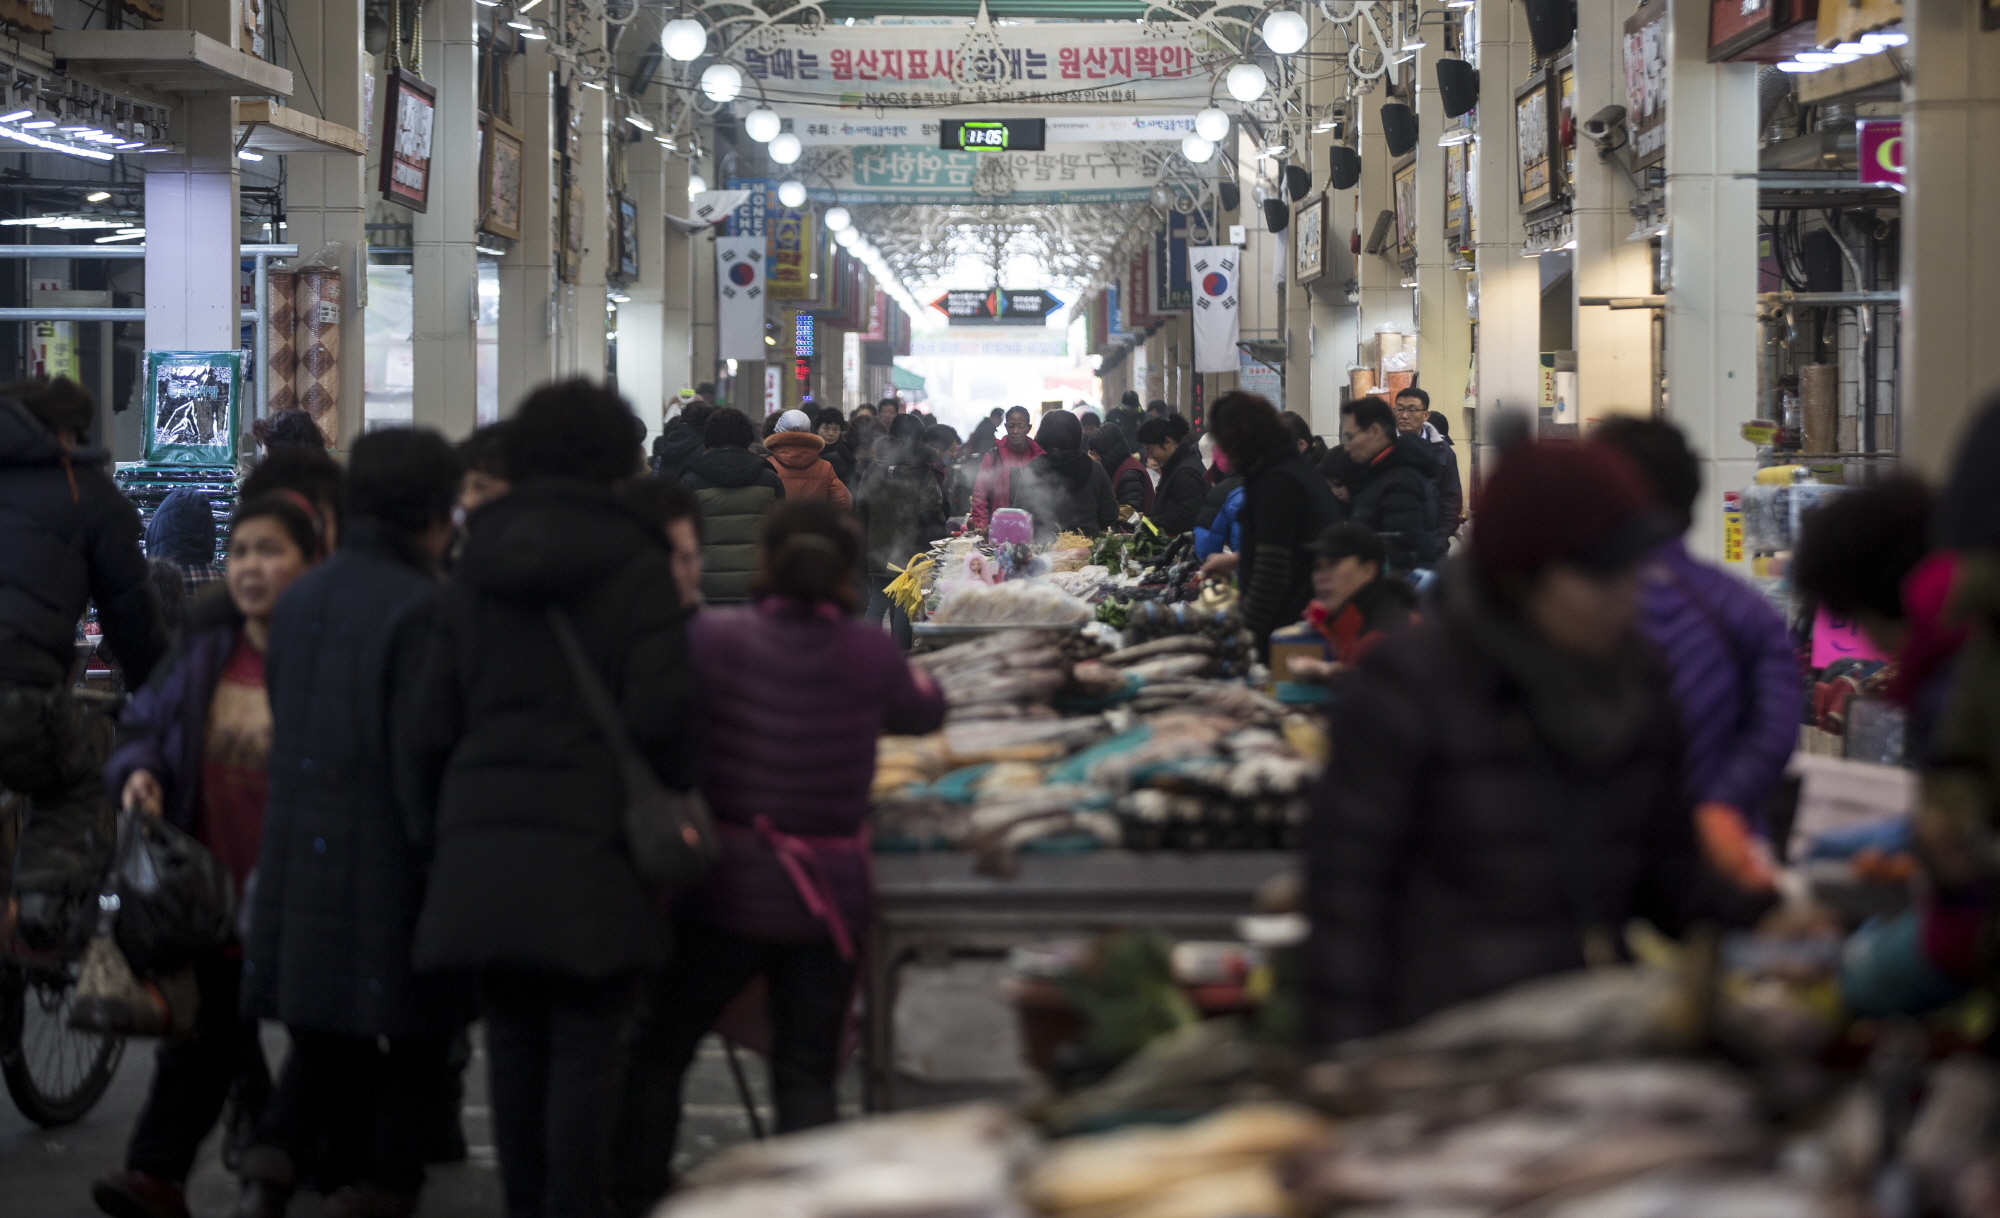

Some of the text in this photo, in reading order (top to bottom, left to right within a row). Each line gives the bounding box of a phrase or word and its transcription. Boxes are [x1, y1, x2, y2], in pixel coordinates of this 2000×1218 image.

[1057, 45, 1192, 79] 원산지확인!
[969, 129, 1002, 145] 11:05
[752, 183, 766, 237] MONEY
